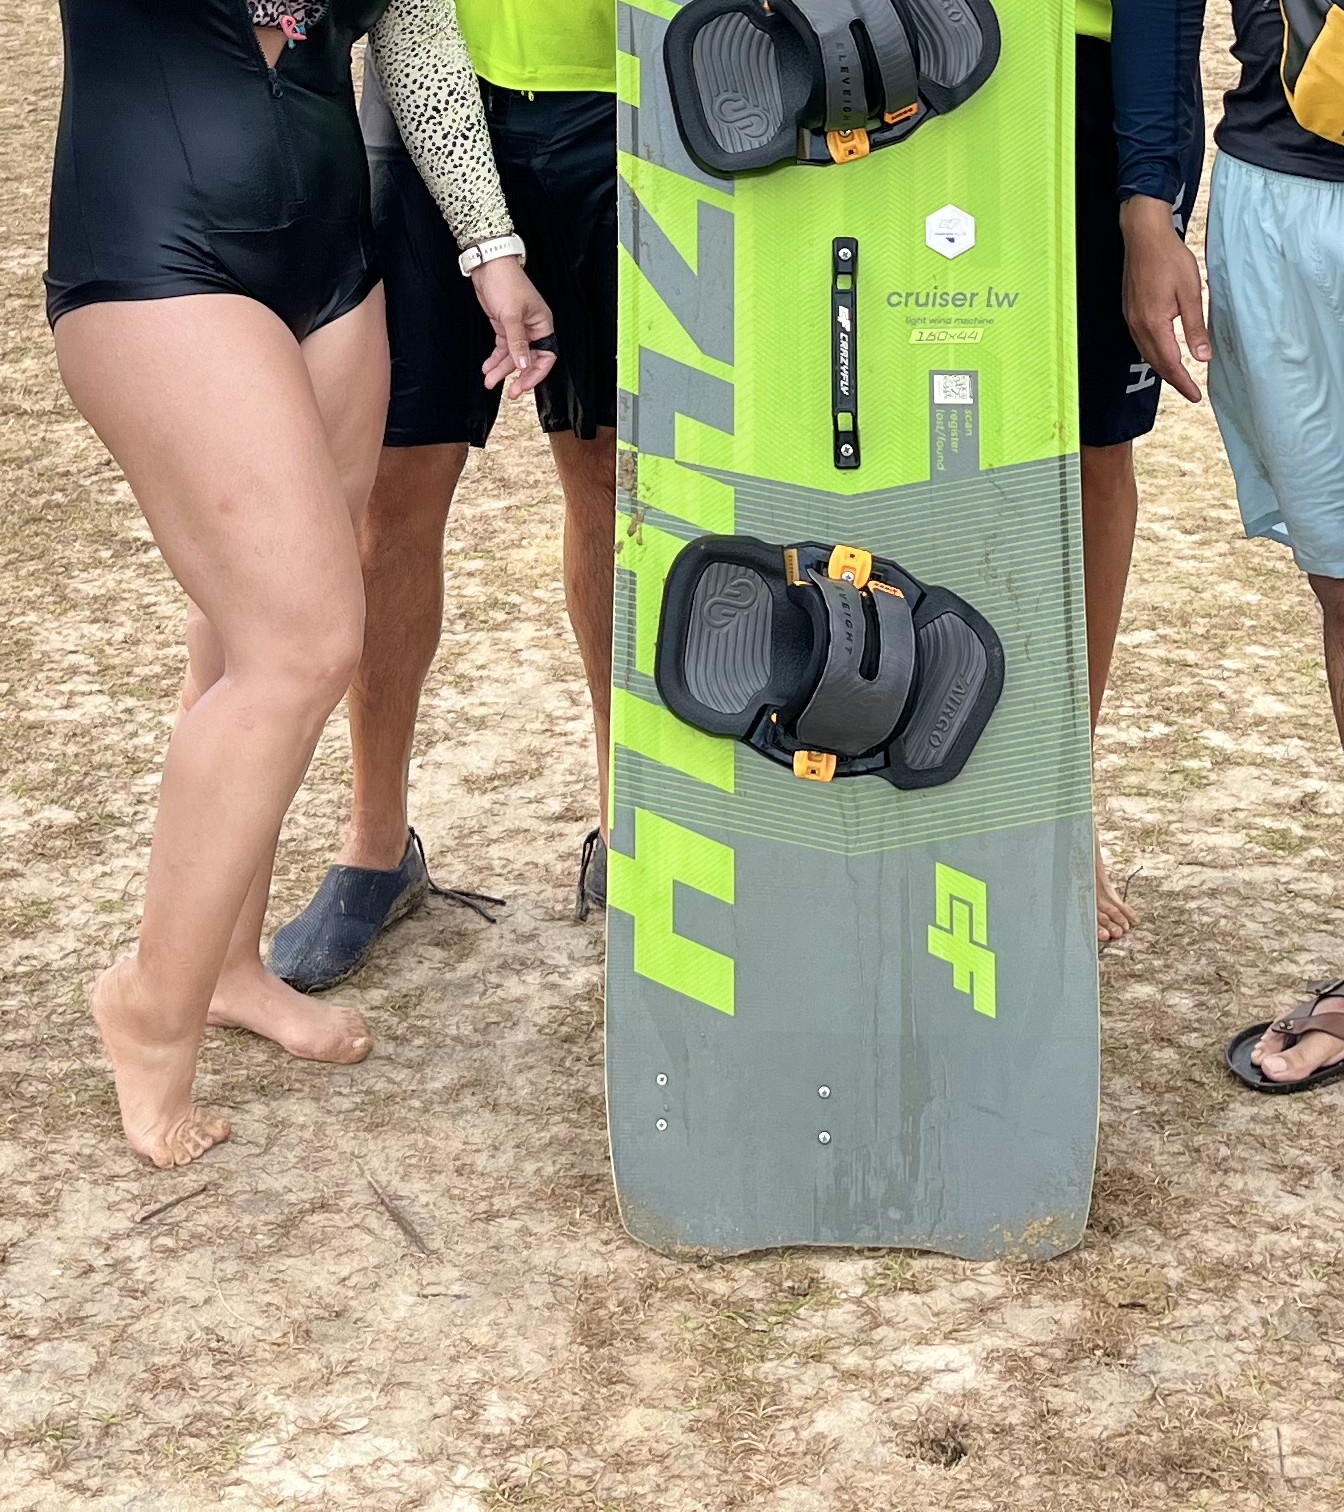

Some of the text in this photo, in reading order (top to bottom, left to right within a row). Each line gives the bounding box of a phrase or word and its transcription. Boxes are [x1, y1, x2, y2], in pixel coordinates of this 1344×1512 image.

[886, 285, 1020, 308] cruiser lw
[905, 316, 927, 326] light
[839, 332, 850, 396] CRAZYFLY
[947, 408, 960, 453] register
[963, 408, 973, 437] scan
[928, 679, 967, 748] AIRGO
